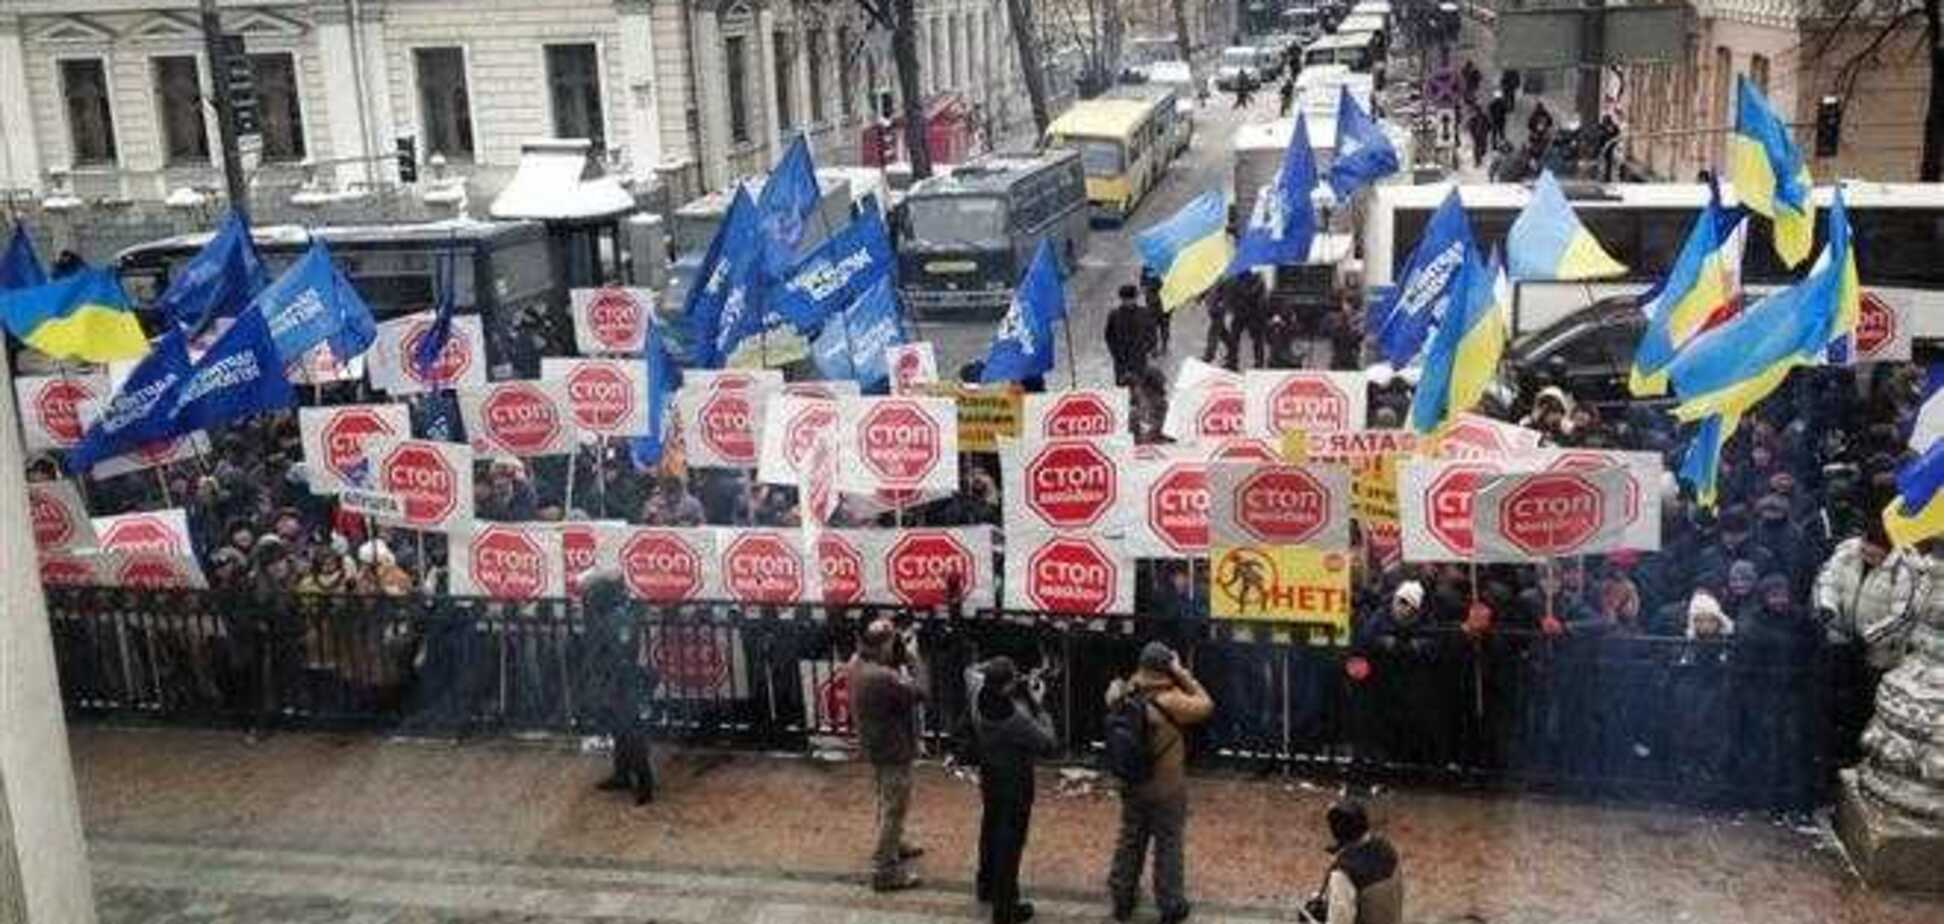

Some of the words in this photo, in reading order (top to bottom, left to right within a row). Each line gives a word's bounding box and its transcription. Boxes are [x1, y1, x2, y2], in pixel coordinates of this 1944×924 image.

[571, 381, 626, 402] СТОП
[491, 403, 551, 424] СТОП
[1279, 397, 1339, 416] СТОП
[709, 411, 748, 430] СТО
[1055, 415, 1106, 434] СТОП
[1205, 414, 1246, 434] СТО
[868, 426, 928, 449] СТОП
[391, 466, 447, 492] СТОП
[1039, 466, 1104, 489] СТОП
[1161, 489, 1210, 511] СТО
[1245, 489, 1318, 512] СТОП
[1437, 491, 1473, 513] СТ
[1514, 495, 1592, 515] СТОП
[479, 549, 541, 571] СТОП
[629, 552, 691, 574] СТОП
[733, 555, 793, 577] СТОП
[822, 556, 854, 578] ОП
[899, 556, 963, 579] СТОП
[1039, 561, 1104, 585] СТОП
[1273, 586, 1346, 613] НЕТ!
